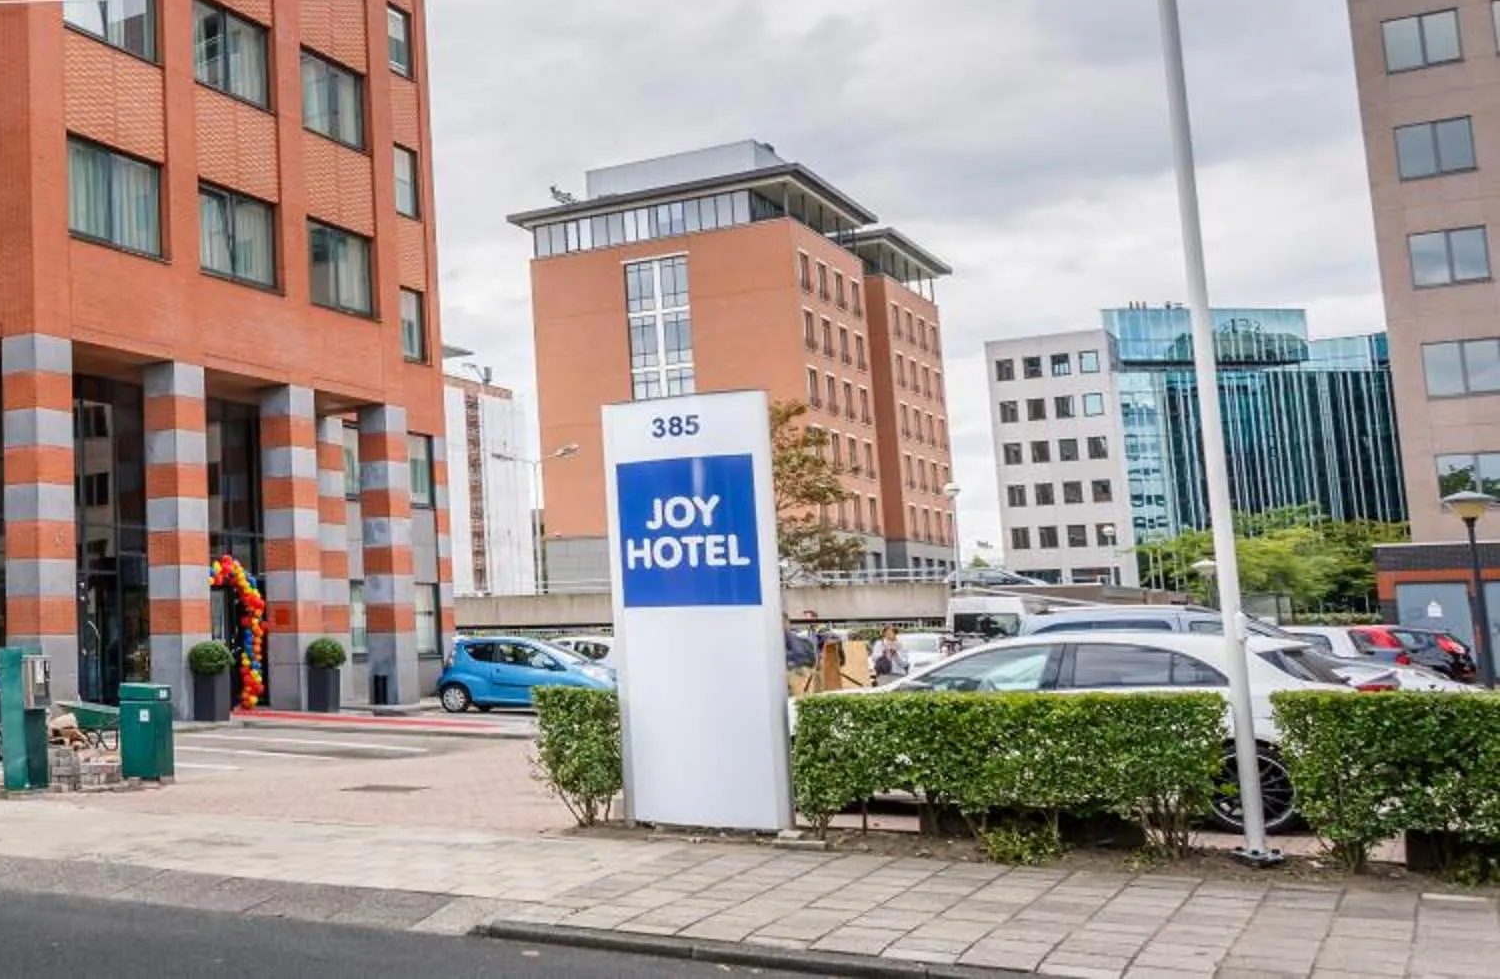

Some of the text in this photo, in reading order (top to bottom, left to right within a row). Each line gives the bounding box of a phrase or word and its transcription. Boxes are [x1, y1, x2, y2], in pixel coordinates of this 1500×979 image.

[652, 415, 700, 438] 385
[645, 495, 720, 530] JOY
[627, 534, 751, 569] HOTEL
